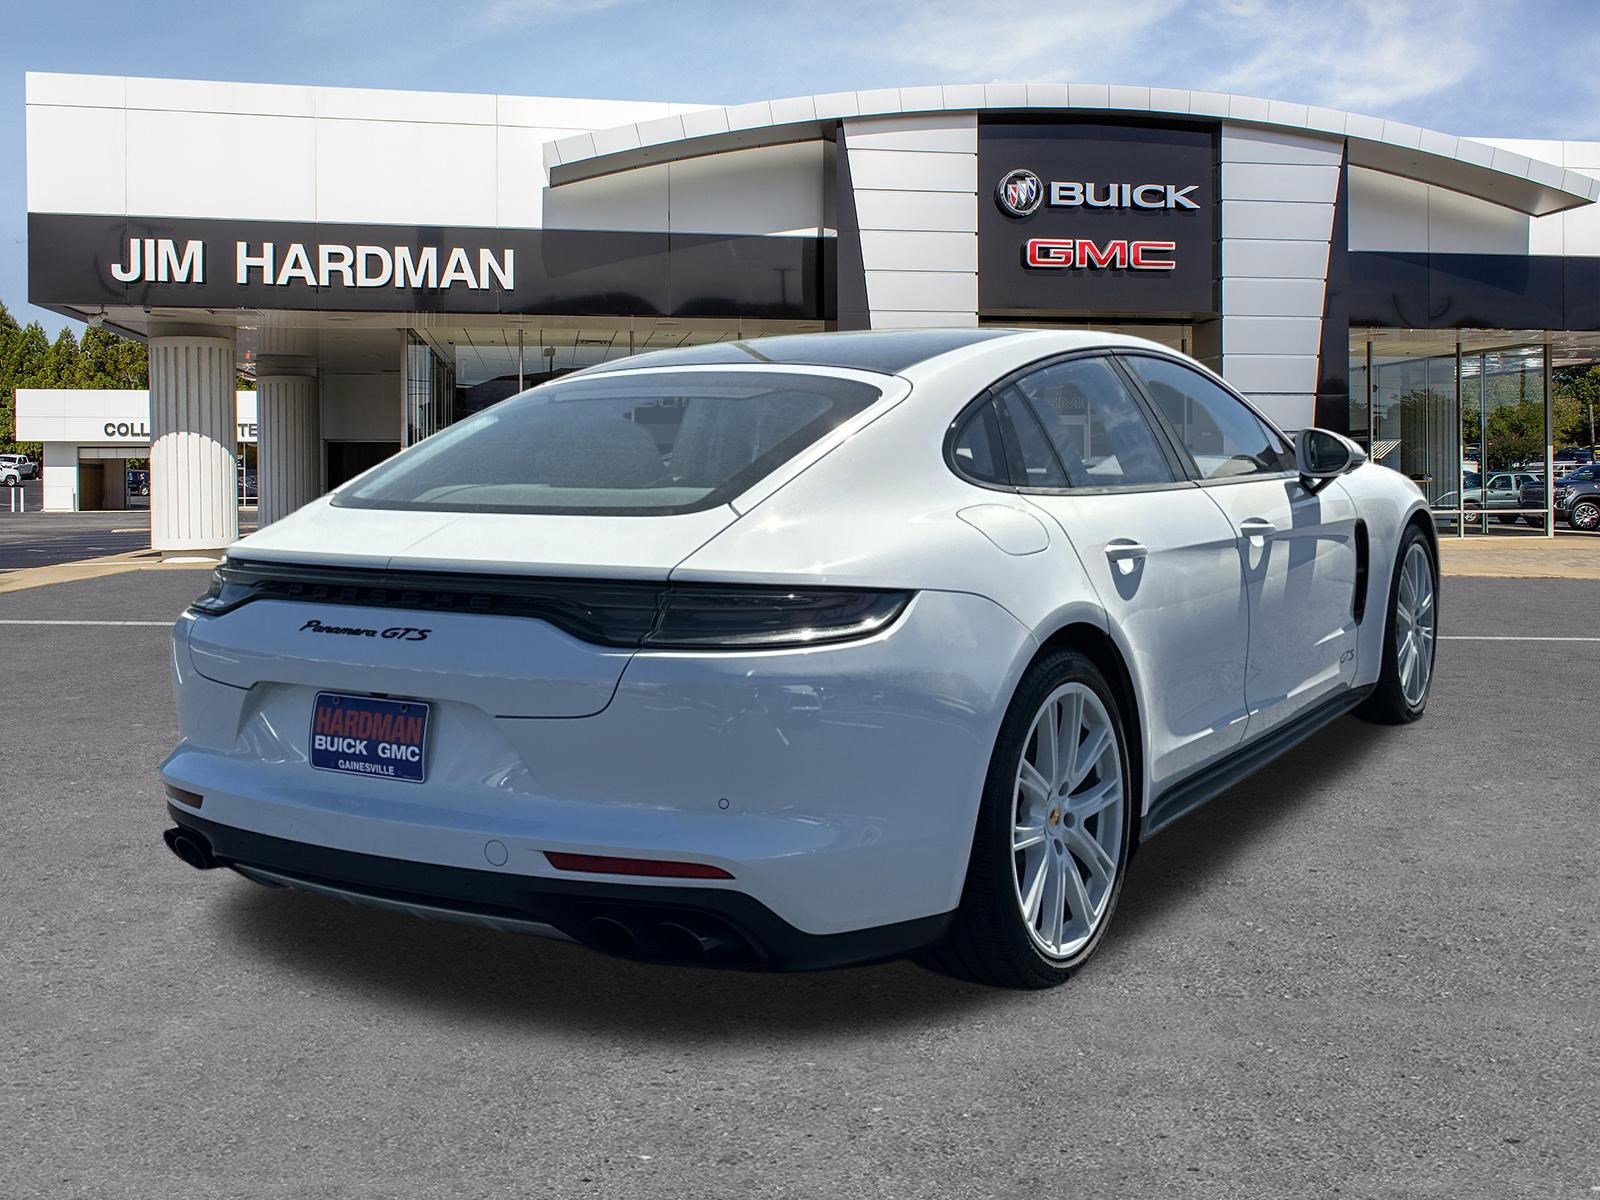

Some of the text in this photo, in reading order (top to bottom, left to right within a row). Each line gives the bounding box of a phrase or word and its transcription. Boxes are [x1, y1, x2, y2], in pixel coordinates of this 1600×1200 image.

[1050, 181, 1200, 209] BUICK
[111, 238, 514, 290] JIM HARDMAN
[1026, 238, 1176, 270] GMC
[104, 422, 258, 437] COLL TE
[299, 619, 432, 641] Panamera GTS
[316, 706, 423, 745] HARDMAN
[314, 735, 420, 762] BUICK GMC
[338, 759, 395, 775] GAINESVILLE
